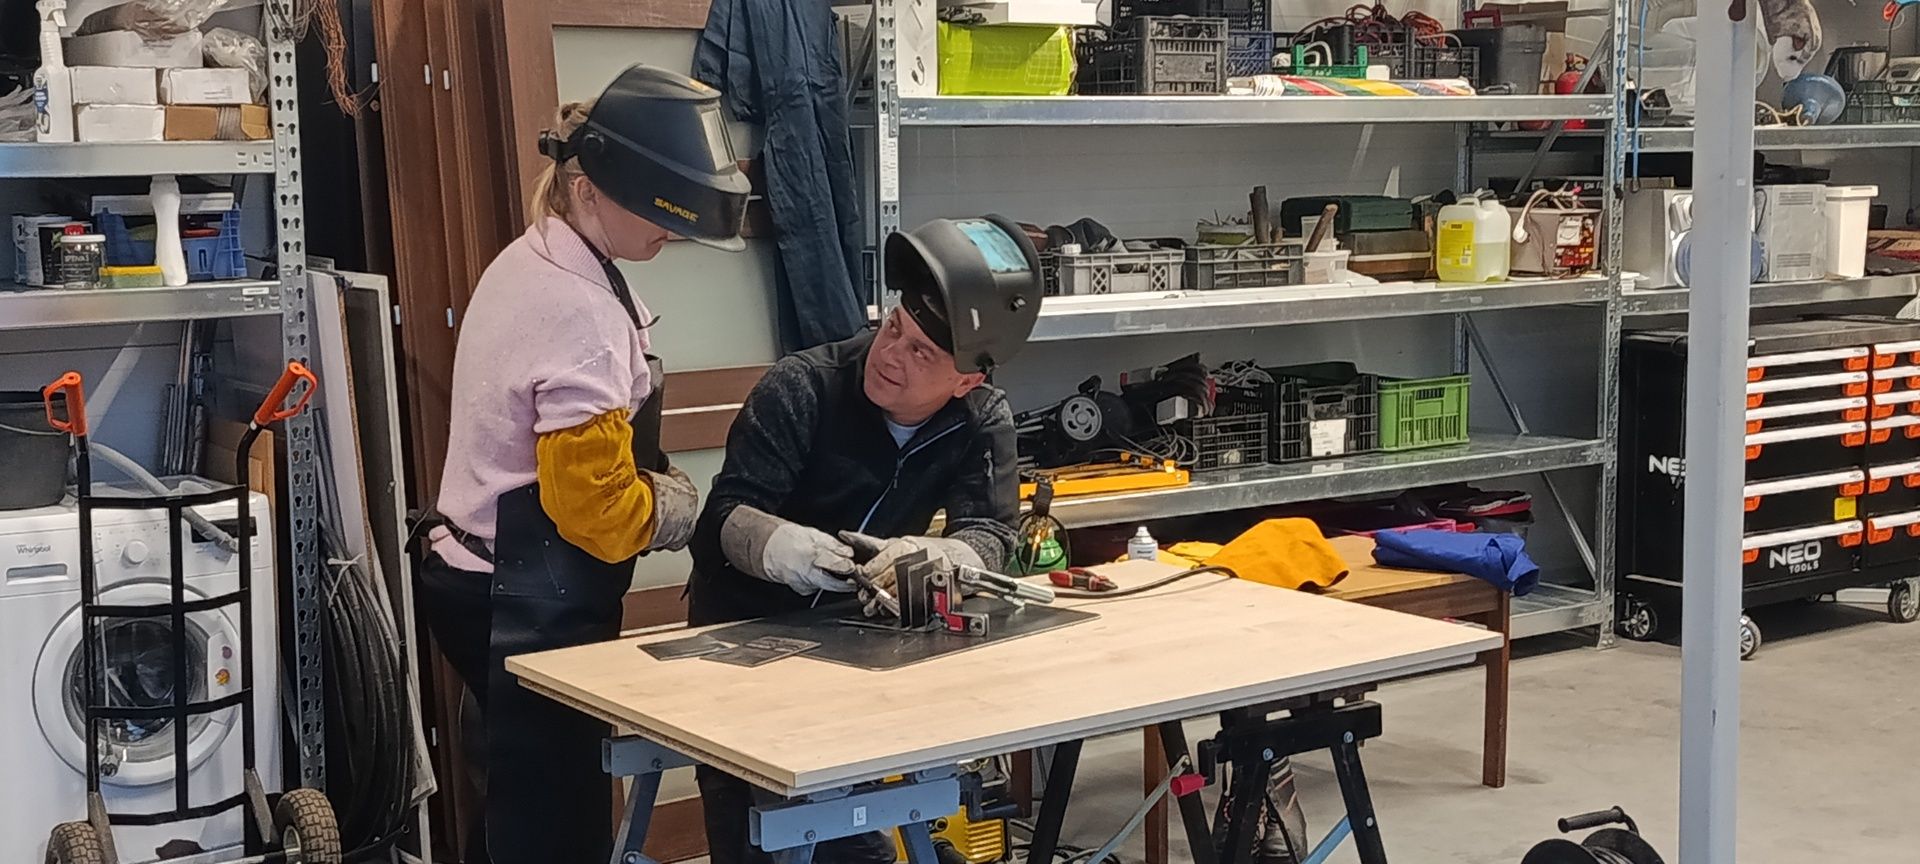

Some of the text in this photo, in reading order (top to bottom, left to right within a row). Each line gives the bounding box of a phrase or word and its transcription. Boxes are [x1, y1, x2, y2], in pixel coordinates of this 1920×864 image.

[654, 197, 699, 223] SAVAGE
[16, 545, 52, 555] Whirlpool
[1769, 540, 1822, 569] NEO
[1788, 560, 1819, 574] TOOLS
[856, 812, 864, 821] L
